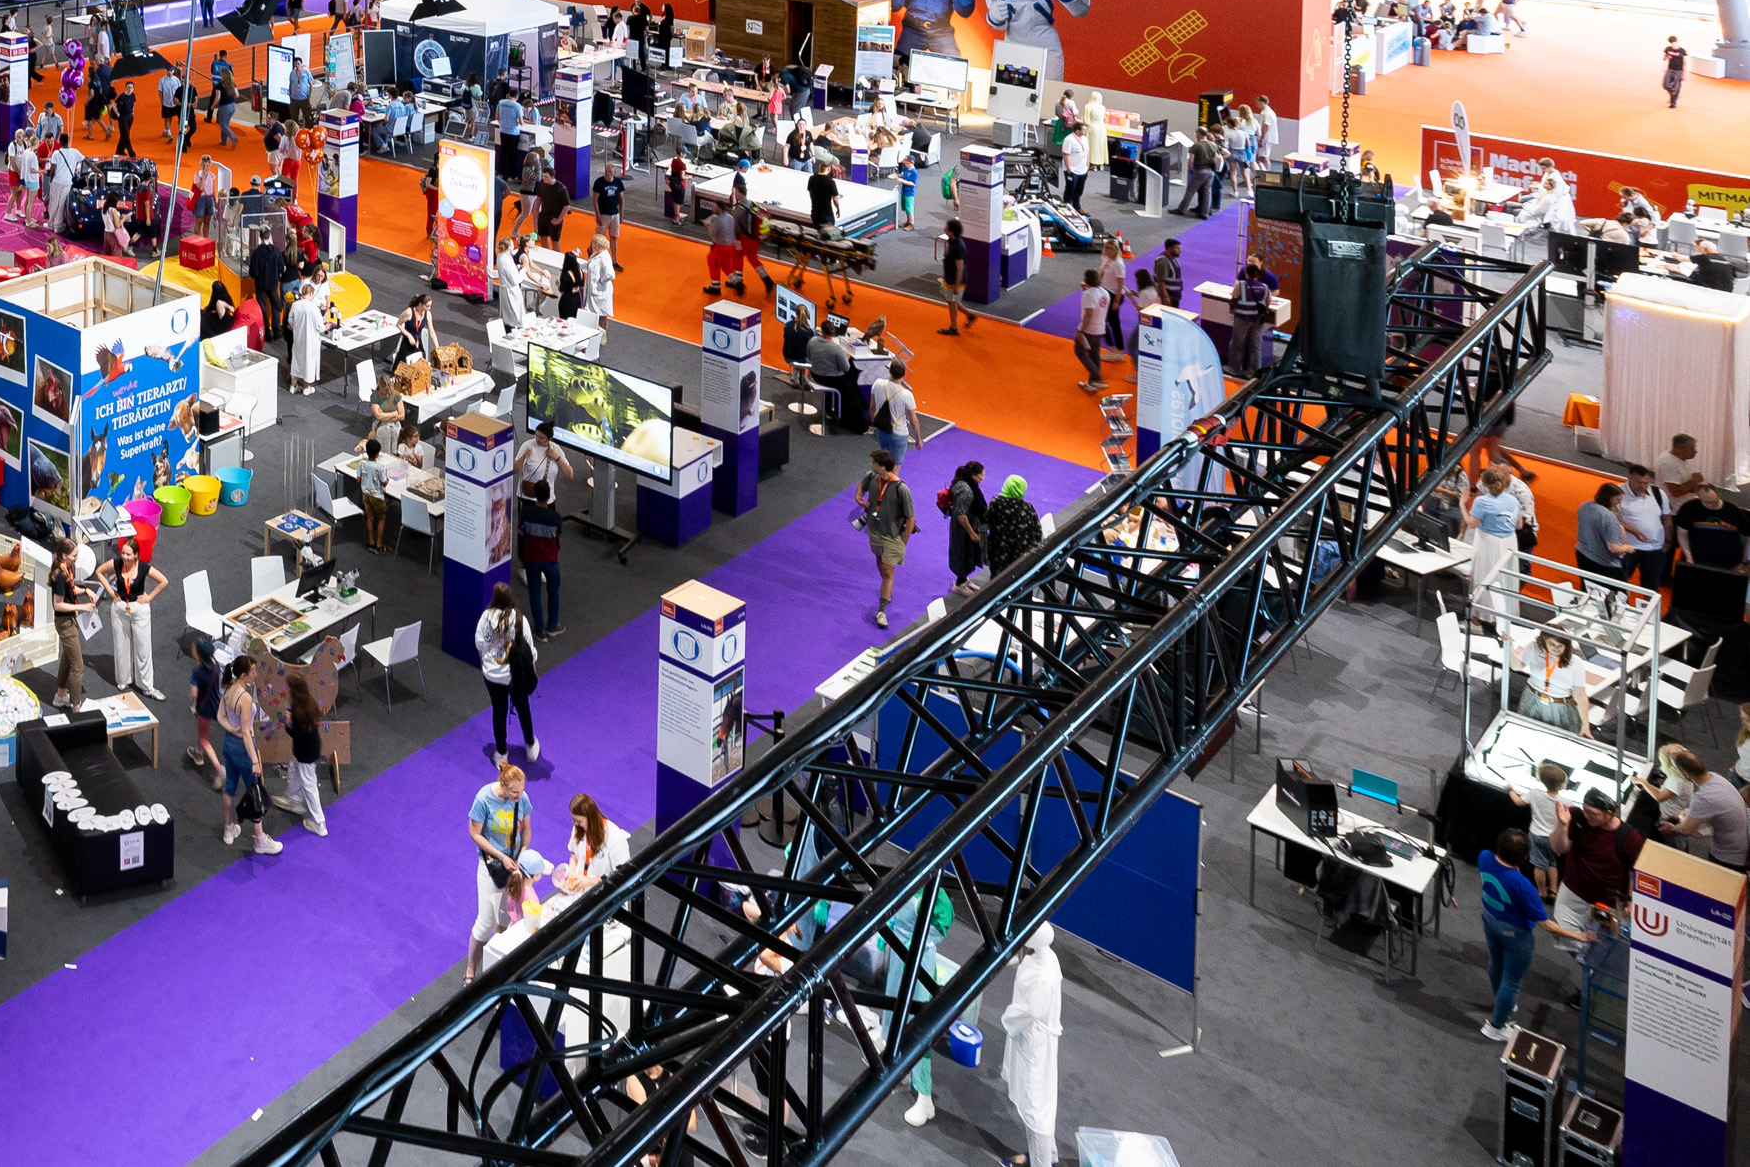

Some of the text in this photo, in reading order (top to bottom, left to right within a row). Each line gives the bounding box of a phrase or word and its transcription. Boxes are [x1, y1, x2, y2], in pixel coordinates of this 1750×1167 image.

[1489, 153, 1540, 176] Mach
[450, 177, 478, 191] Zukunft
[95, 376, 188, 420] ICH BIN TIERARZT/
[111, 399, 171, 431] TIERÄRZTIN
[117, 423, 166, 447] Was ist deine
[120, 435, 163, 460] Superkraft?
[1675, 927, 1716, 948] Bremen
[1676, 919, 1732, 947] Universität
[1634, 957, 1704, 990] Universität Bremen
